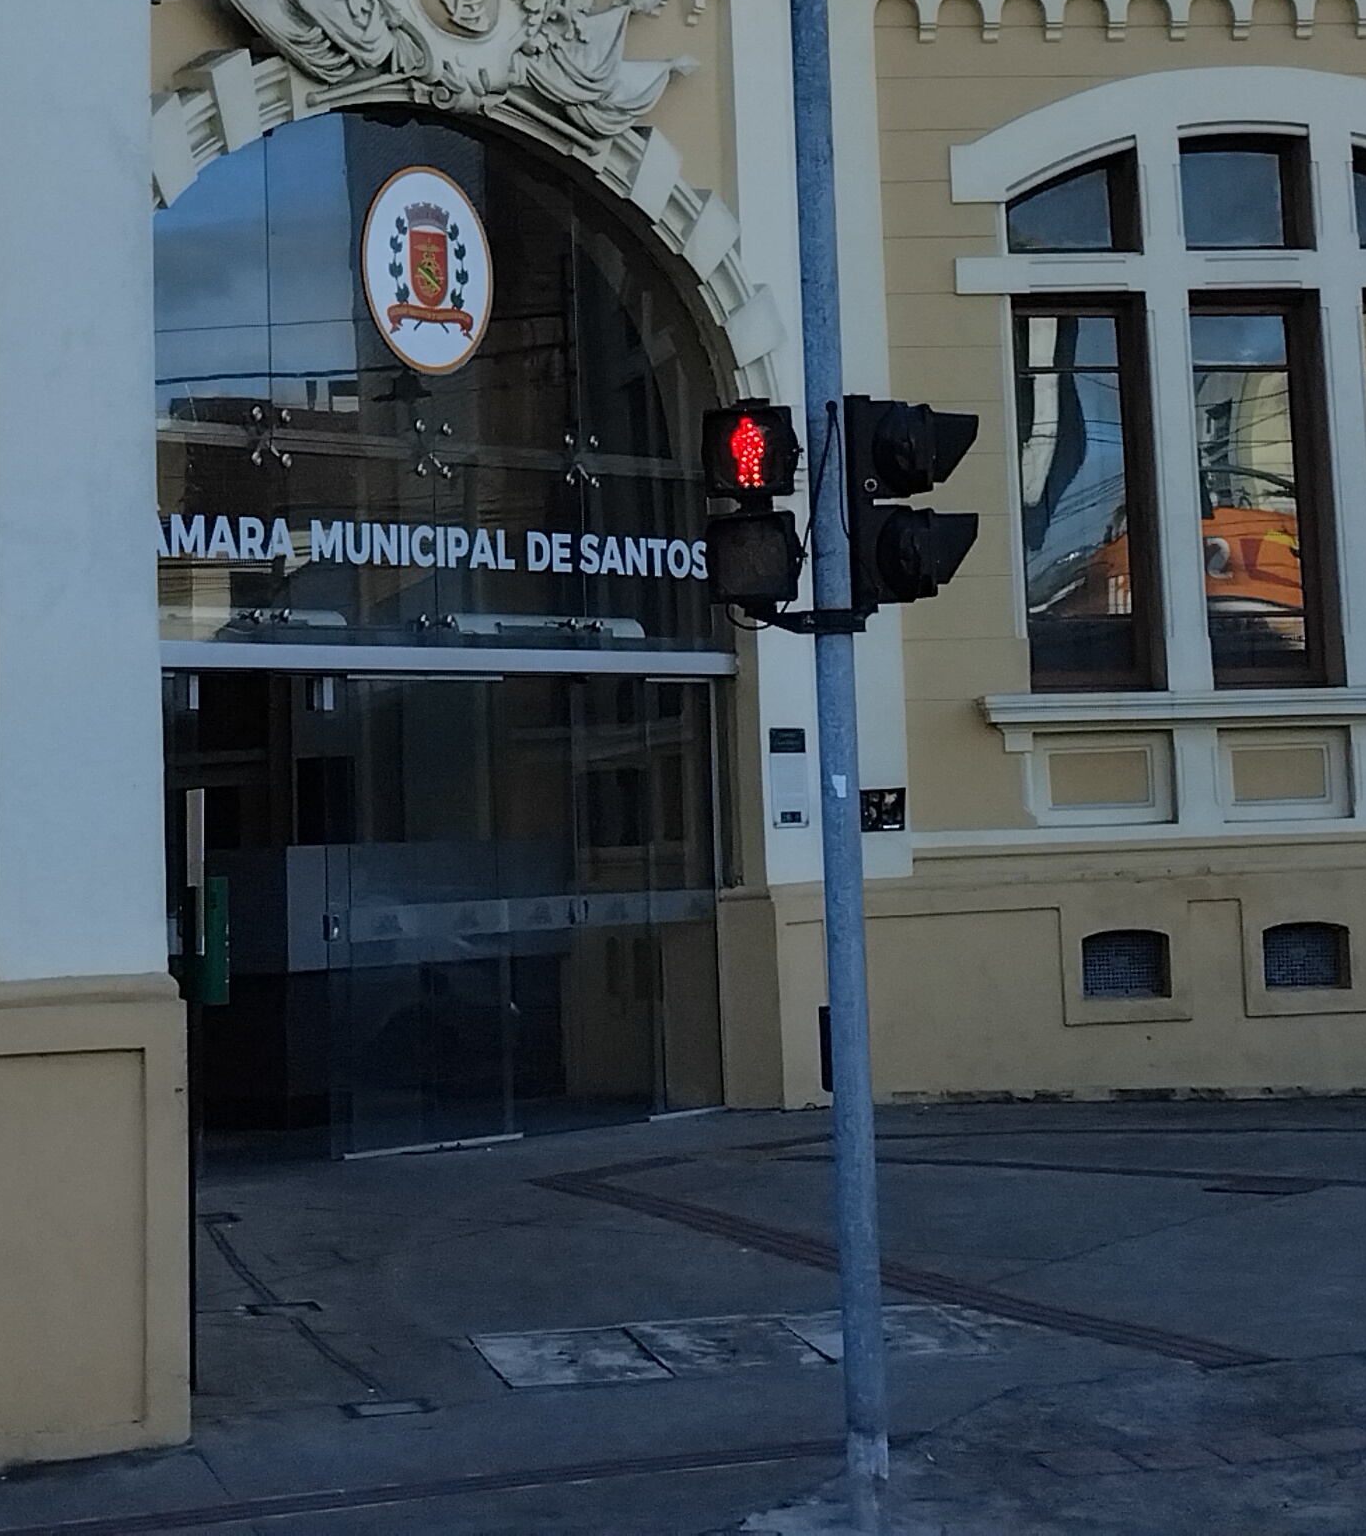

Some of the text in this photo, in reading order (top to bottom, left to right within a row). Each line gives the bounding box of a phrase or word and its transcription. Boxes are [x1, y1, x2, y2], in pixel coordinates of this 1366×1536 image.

[311, 518, 516, 571] MUNICIPAL
[528, 530, 573, 573] DE
[580, 533, 708, 580] SANTOS
